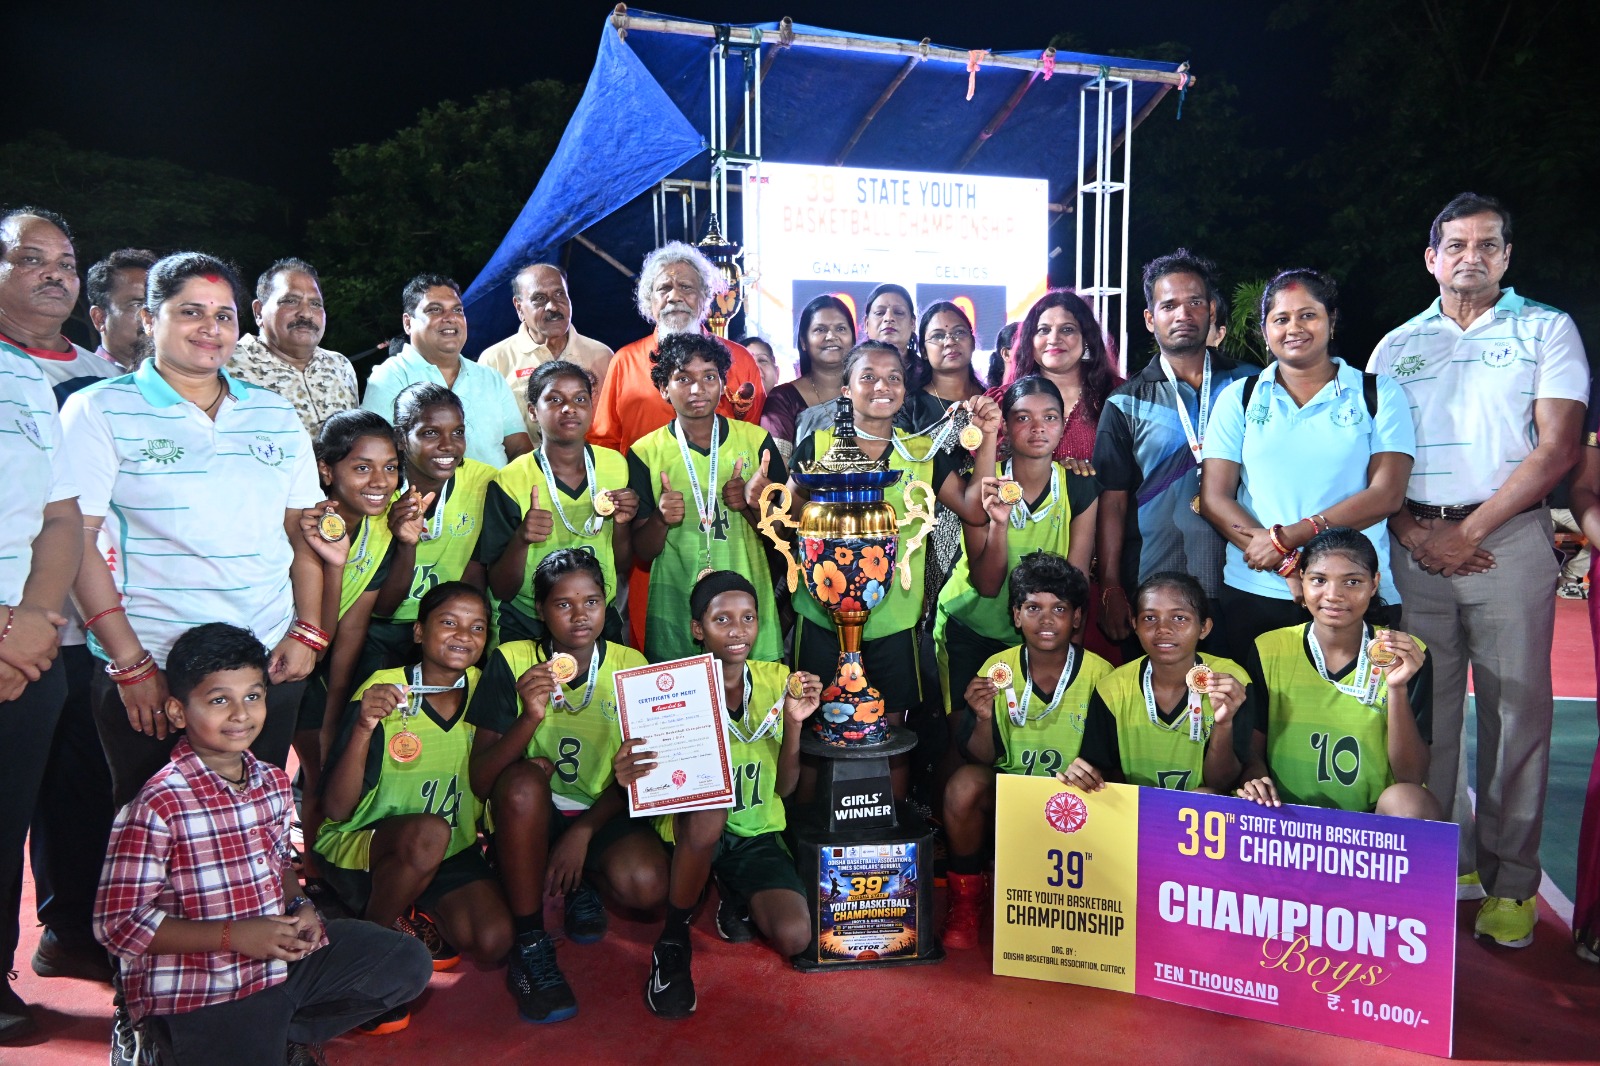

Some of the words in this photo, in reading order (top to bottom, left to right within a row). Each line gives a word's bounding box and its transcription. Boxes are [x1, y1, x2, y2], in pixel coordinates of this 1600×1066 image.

[857, 177, 911, 206] STATE
[919, 181, 977, 209] YOUTH
[783, 206, 891, 237] BASKETBALL
[900, 211, 1014, 240] CHAMPIONSHIP
[812, 260, 871, 275] GANJAM
[935, 265, 989, 279] CELTICS
[698, 494, 730, 541] 4
[638, 694, 670, 704] CERTIFICATE
[554, 737, 581, 784] 8
[1310, 732, 1360, 786] 10
[1156, 770, 1192, 790] 7
[834, 804, 892, 820] WINNER
[840, 792, 883, 807] GIRLS'
[1240, 815, 1276, 835] STATE
[1280, 820, 1322, 840] YOUTH
[1326, 826, 1408, 852] BASKETBALL
[1240, 835, 1409, 884] CHAMPIONSHIP
[830, 901, 858, 912] YOUTH
[859, 898, 910, 910] BASKETBALL
[833, 908, 906, 922] CHAMPIONSHIP
[1006, 888, 1032, 902] STATE
[1035, 891, 1064, 906] YOUTH
[1067, 894, 1123, 914] BASKETBALL
[1006, 904, 1124, 937] CHAMPIONSHIP
[1158, 880, 1428, 964] CHAMPION'S
[1003, 952, 1024, 962] ODISHA
[1026, 954, 1059, 966] BASKETBALL
[1060, 958, 1099, 972] ASSOCIATION,
[1100, 964, 1126, 975] CUTTACK
[1051, 946, 1064, 955] ORG.
[1260, 932, 1392, 994] Boys
[1154, 962, 1184, 982] TEN
[1188, 970, 1279, 1002] THOUSAND
[1352, 998, 1430, 1028] 10,000/-
